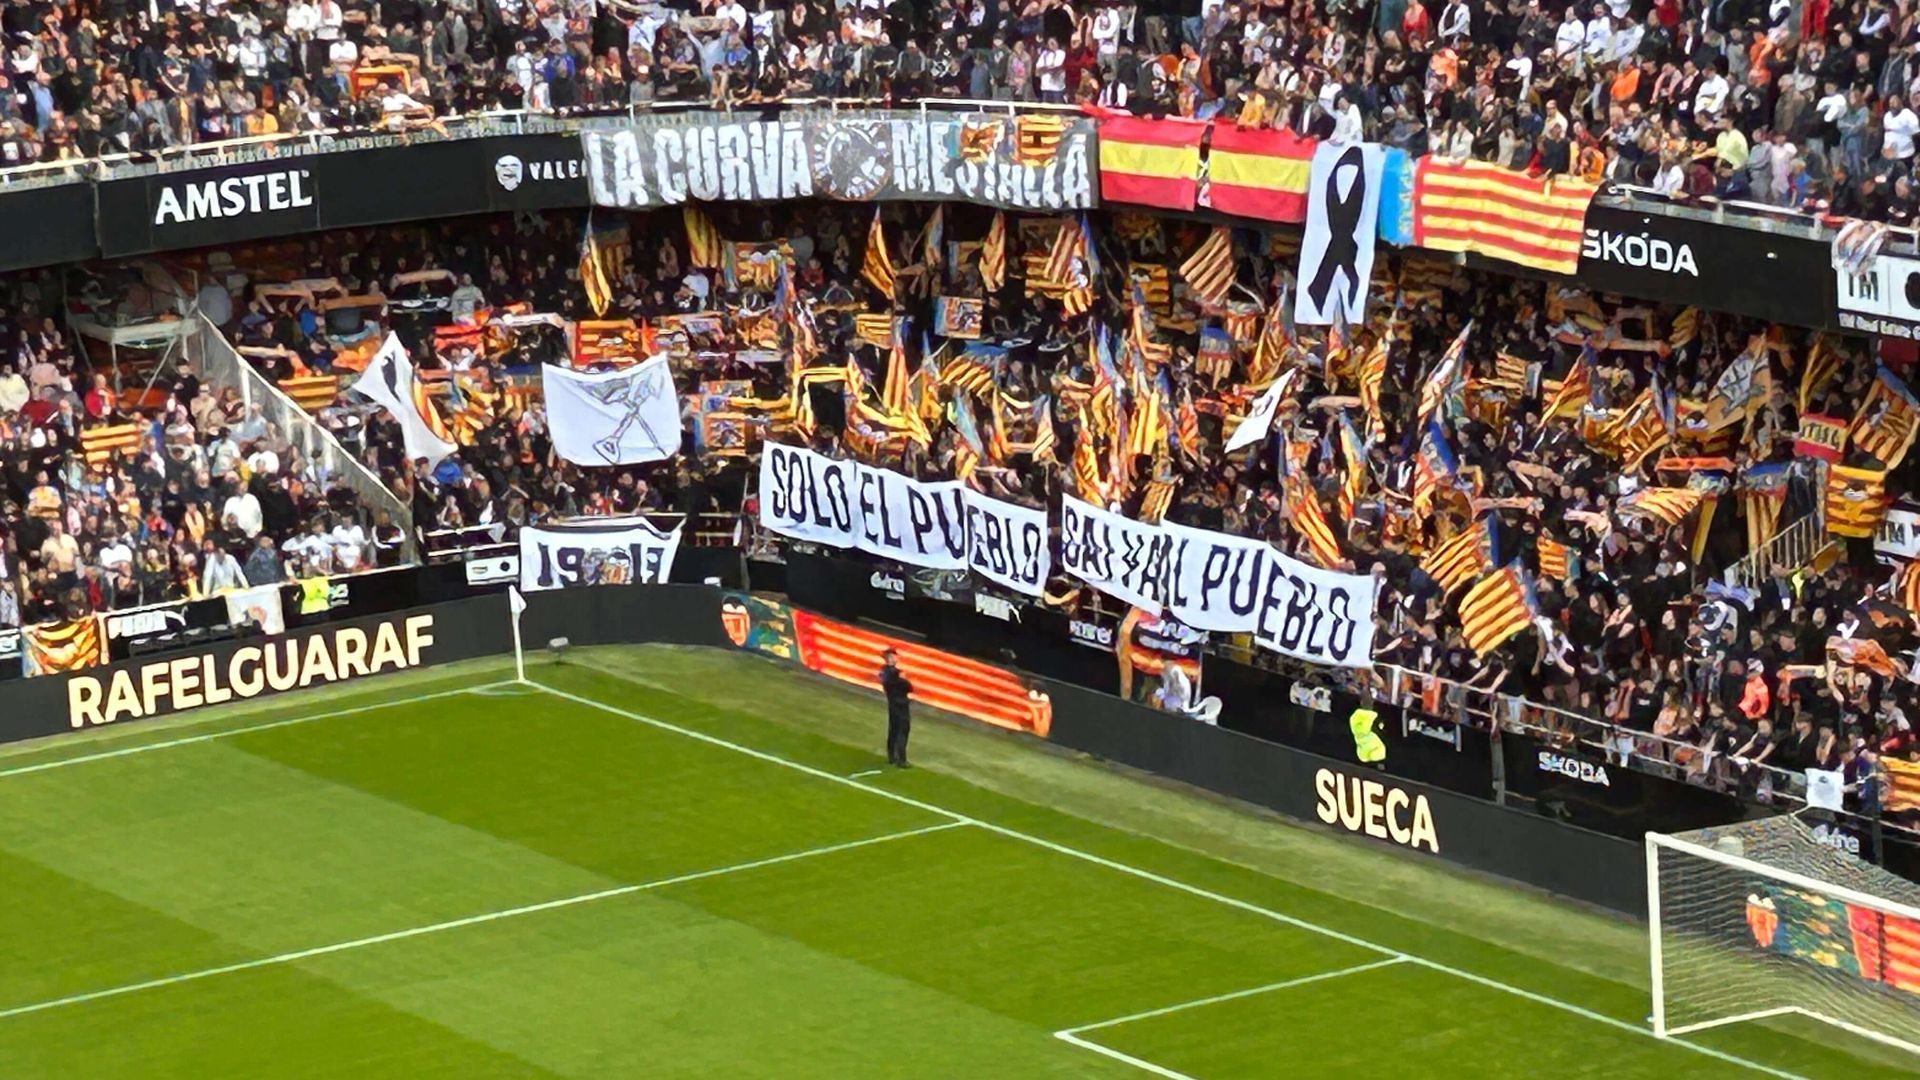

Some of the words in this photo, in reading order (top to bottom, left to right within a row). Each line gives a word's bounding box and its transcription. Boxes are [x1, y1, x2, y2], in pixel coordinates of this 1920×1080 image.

[155, 170, 313, 225] AMSTEL
[529, 159, 588, 181] VALE
[587, 130, 649, 207] LA
[653, 120, 814, 205] CURVA
[771, 448, 852, 533] SOLO
[860, 471, 902, 548] EL
[906, 486, 1041, 586] PUEBLO
[1200, 543, 1356, 661] PUEBLO
[68, 614, 435, 728] RAFELGUARAF
[1315, 768, 1440, 853] SUECA
